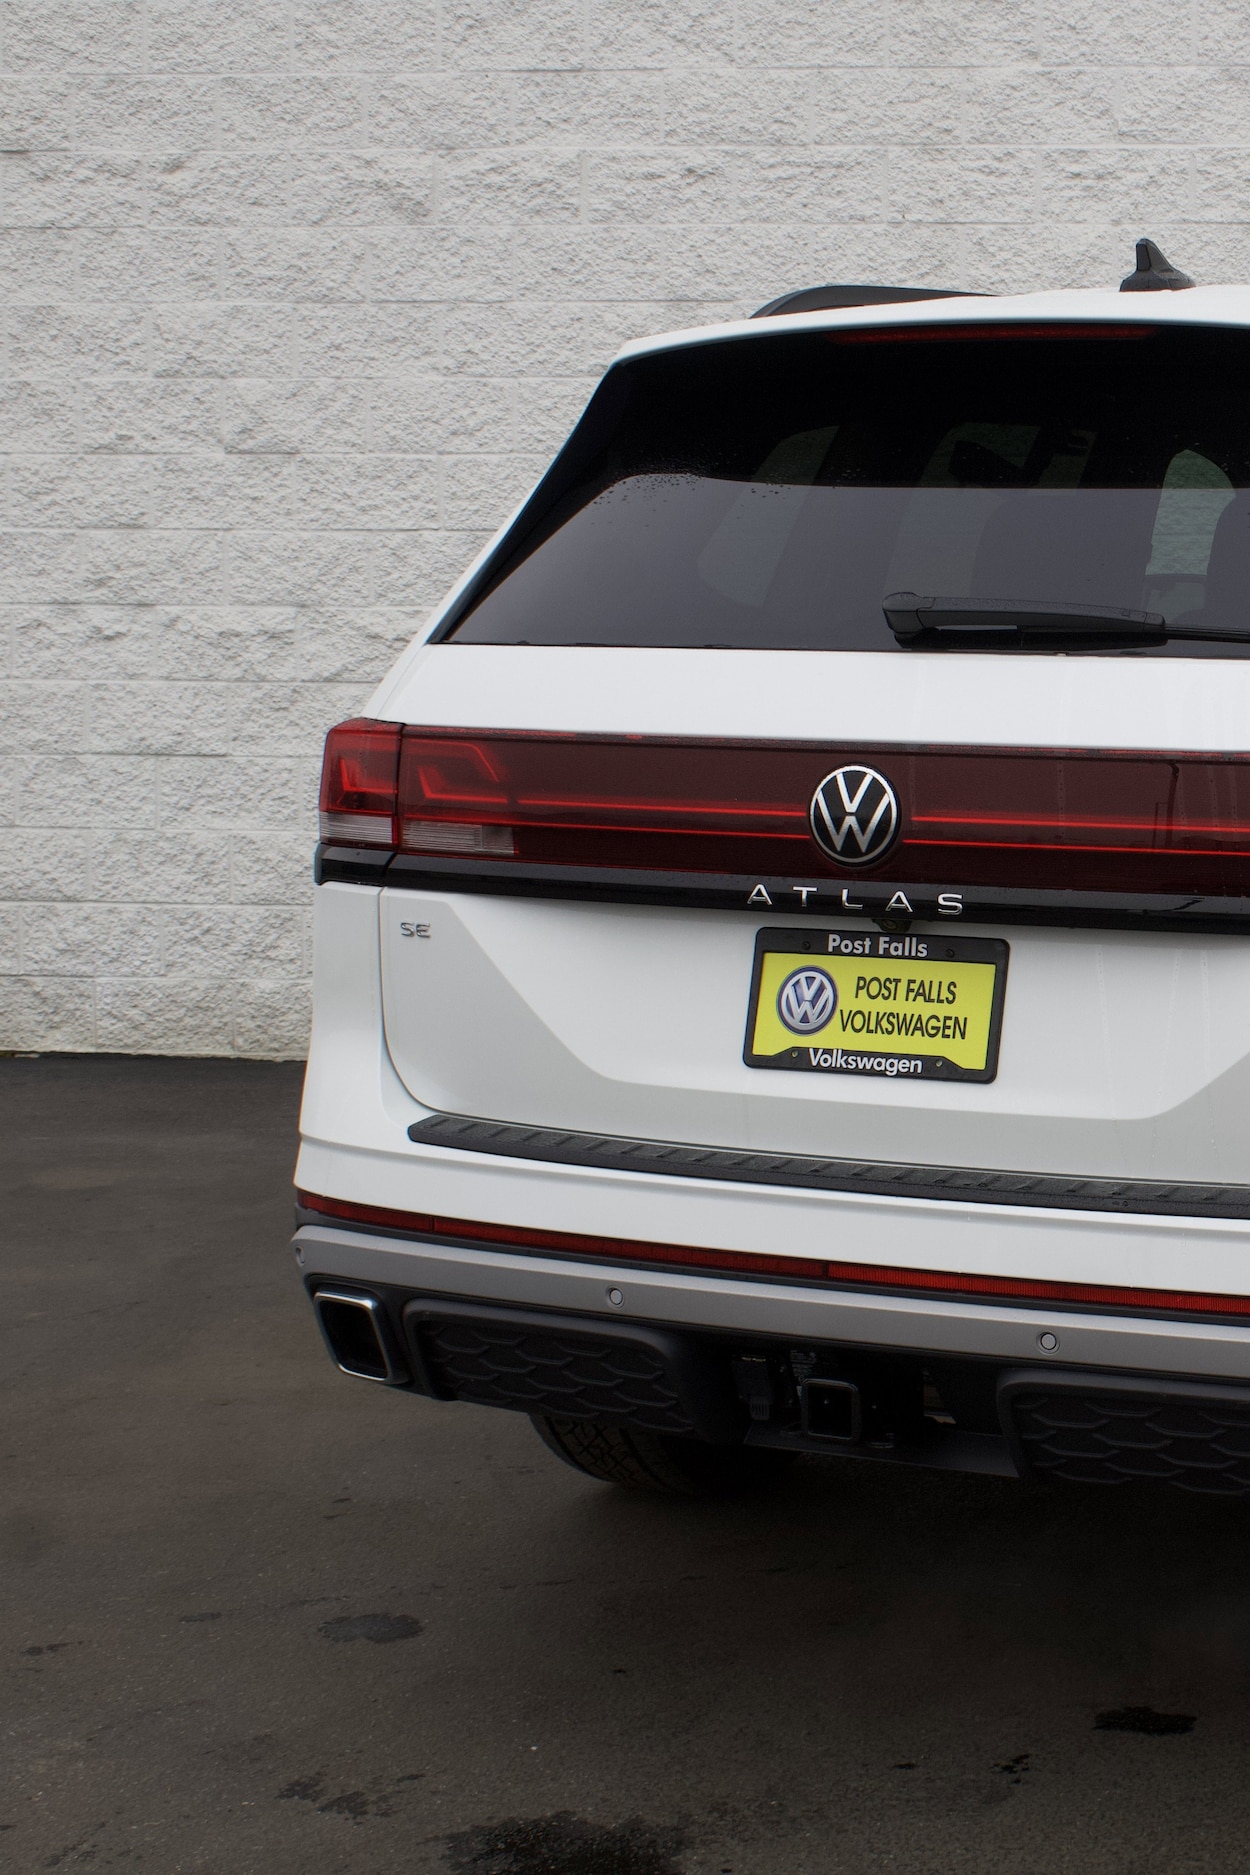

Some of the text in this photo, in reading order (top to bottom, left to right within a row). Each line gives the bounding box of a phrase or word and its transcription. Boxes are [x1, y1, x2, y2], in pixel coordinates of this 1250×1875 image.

[747, 883, 964, 915] ATLAS
[400, 921, 431, 939] SE
[828, 934, 928, 957] Post Falls
[854, 976, 957, 1005] POST FALLS
[839, 1009, 968, 1040] VOLKSWAGEN
[808, 1048, 923, 1076] Volkswagen
